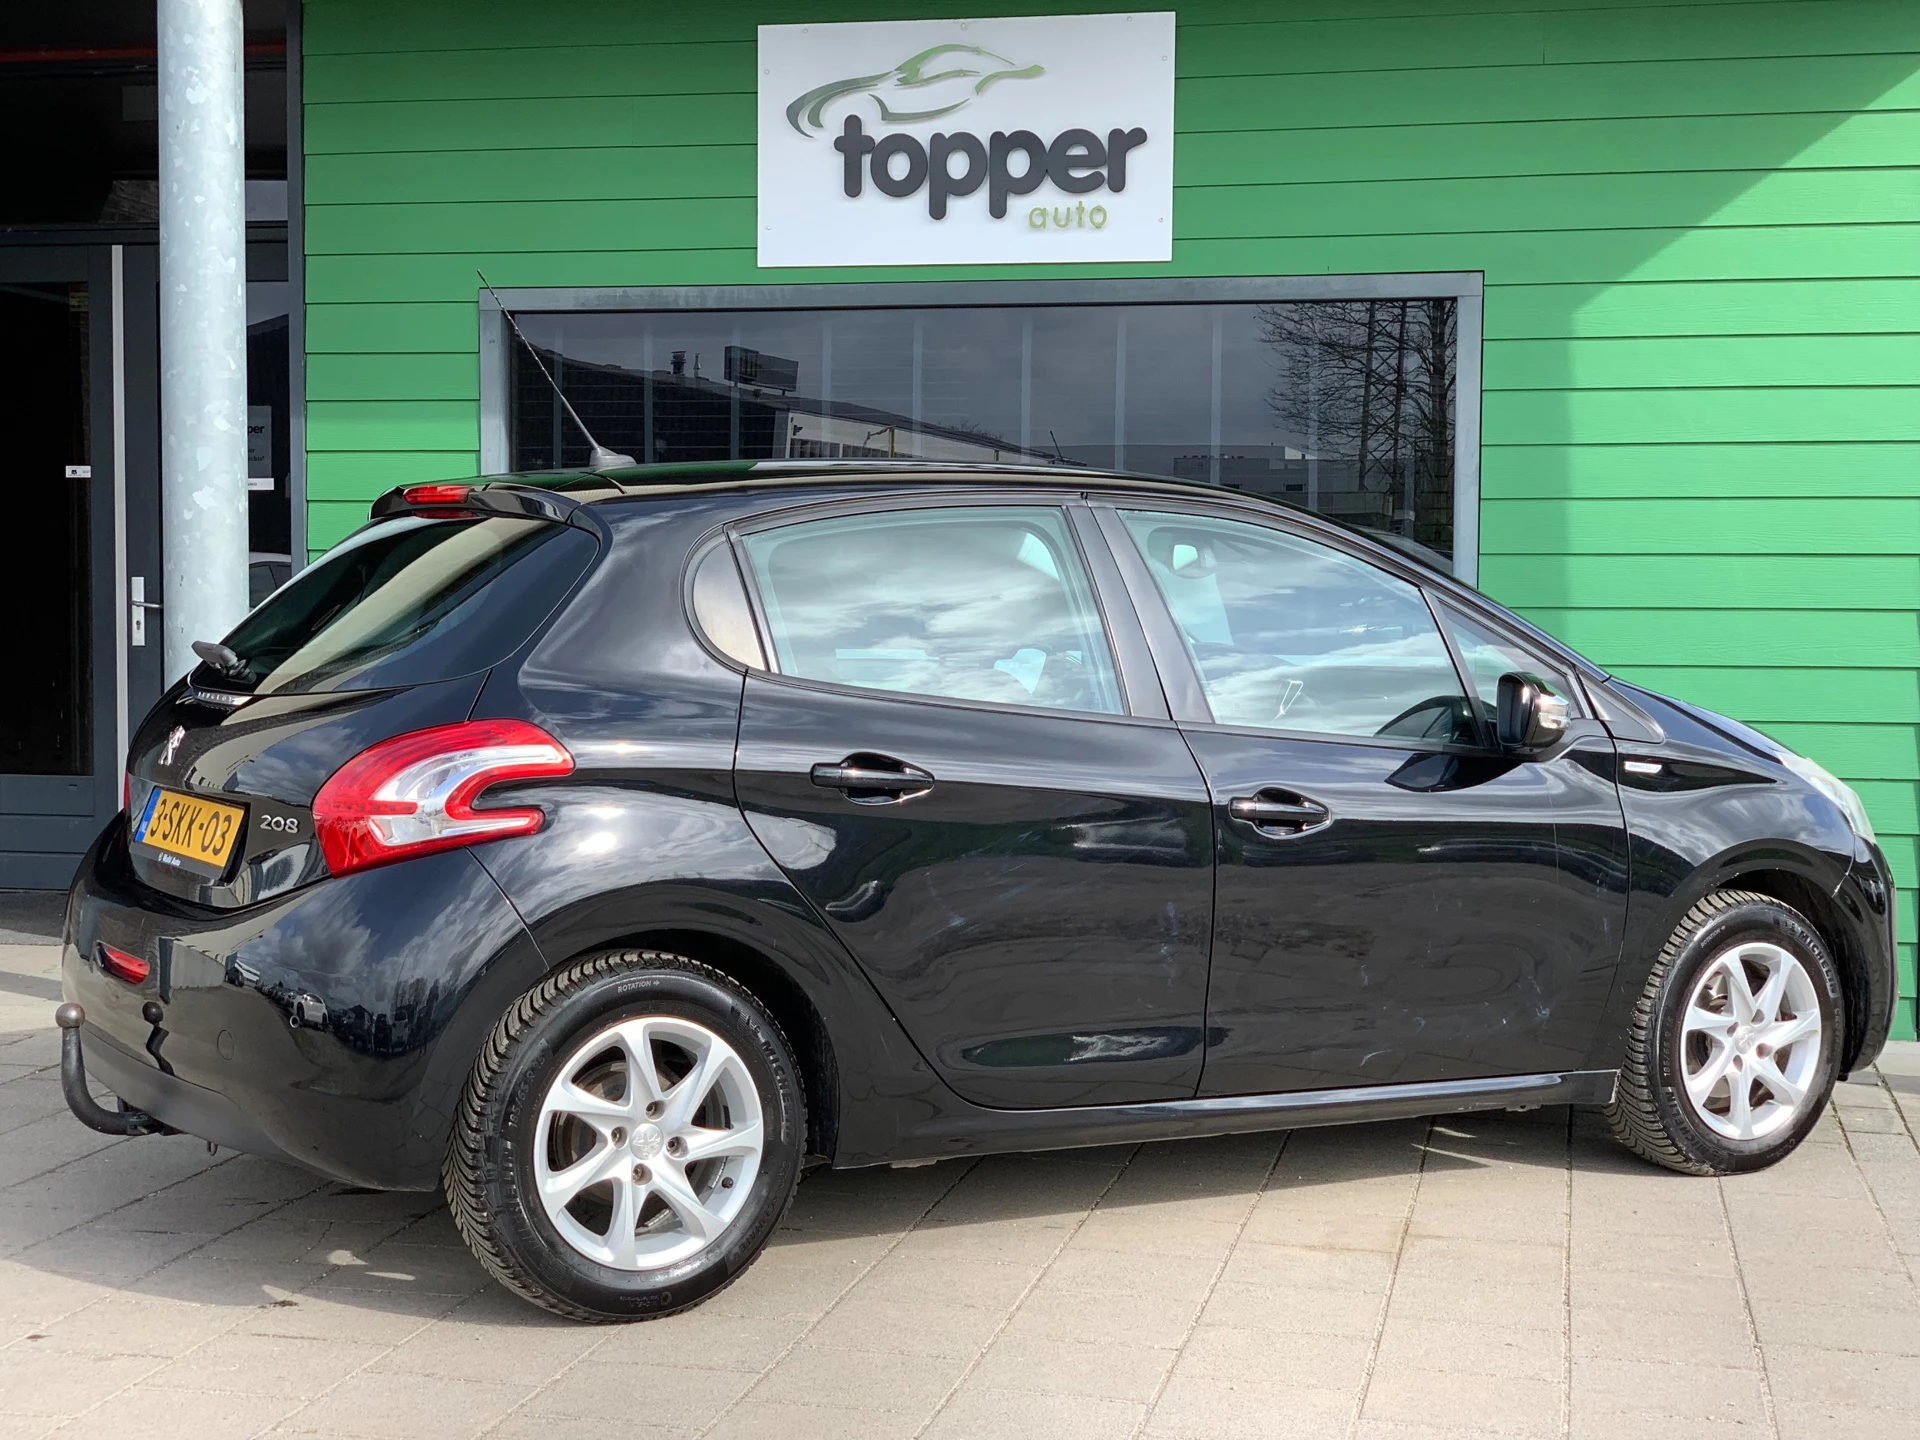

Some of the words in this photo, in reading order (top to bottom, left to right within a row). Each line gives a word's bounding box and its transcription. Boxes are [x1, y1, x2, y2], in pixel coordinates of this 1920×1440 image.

[833, 114, 1148, 220] topper
[1029, 200, 1108, 229] auto
[150, 797, 234, 857] 3-SKK-03
[260, 814, 299, 834] 208
[1799, 931, 1837, 995] MICHELIN
[617, 980, 652, 994] ROTATION
